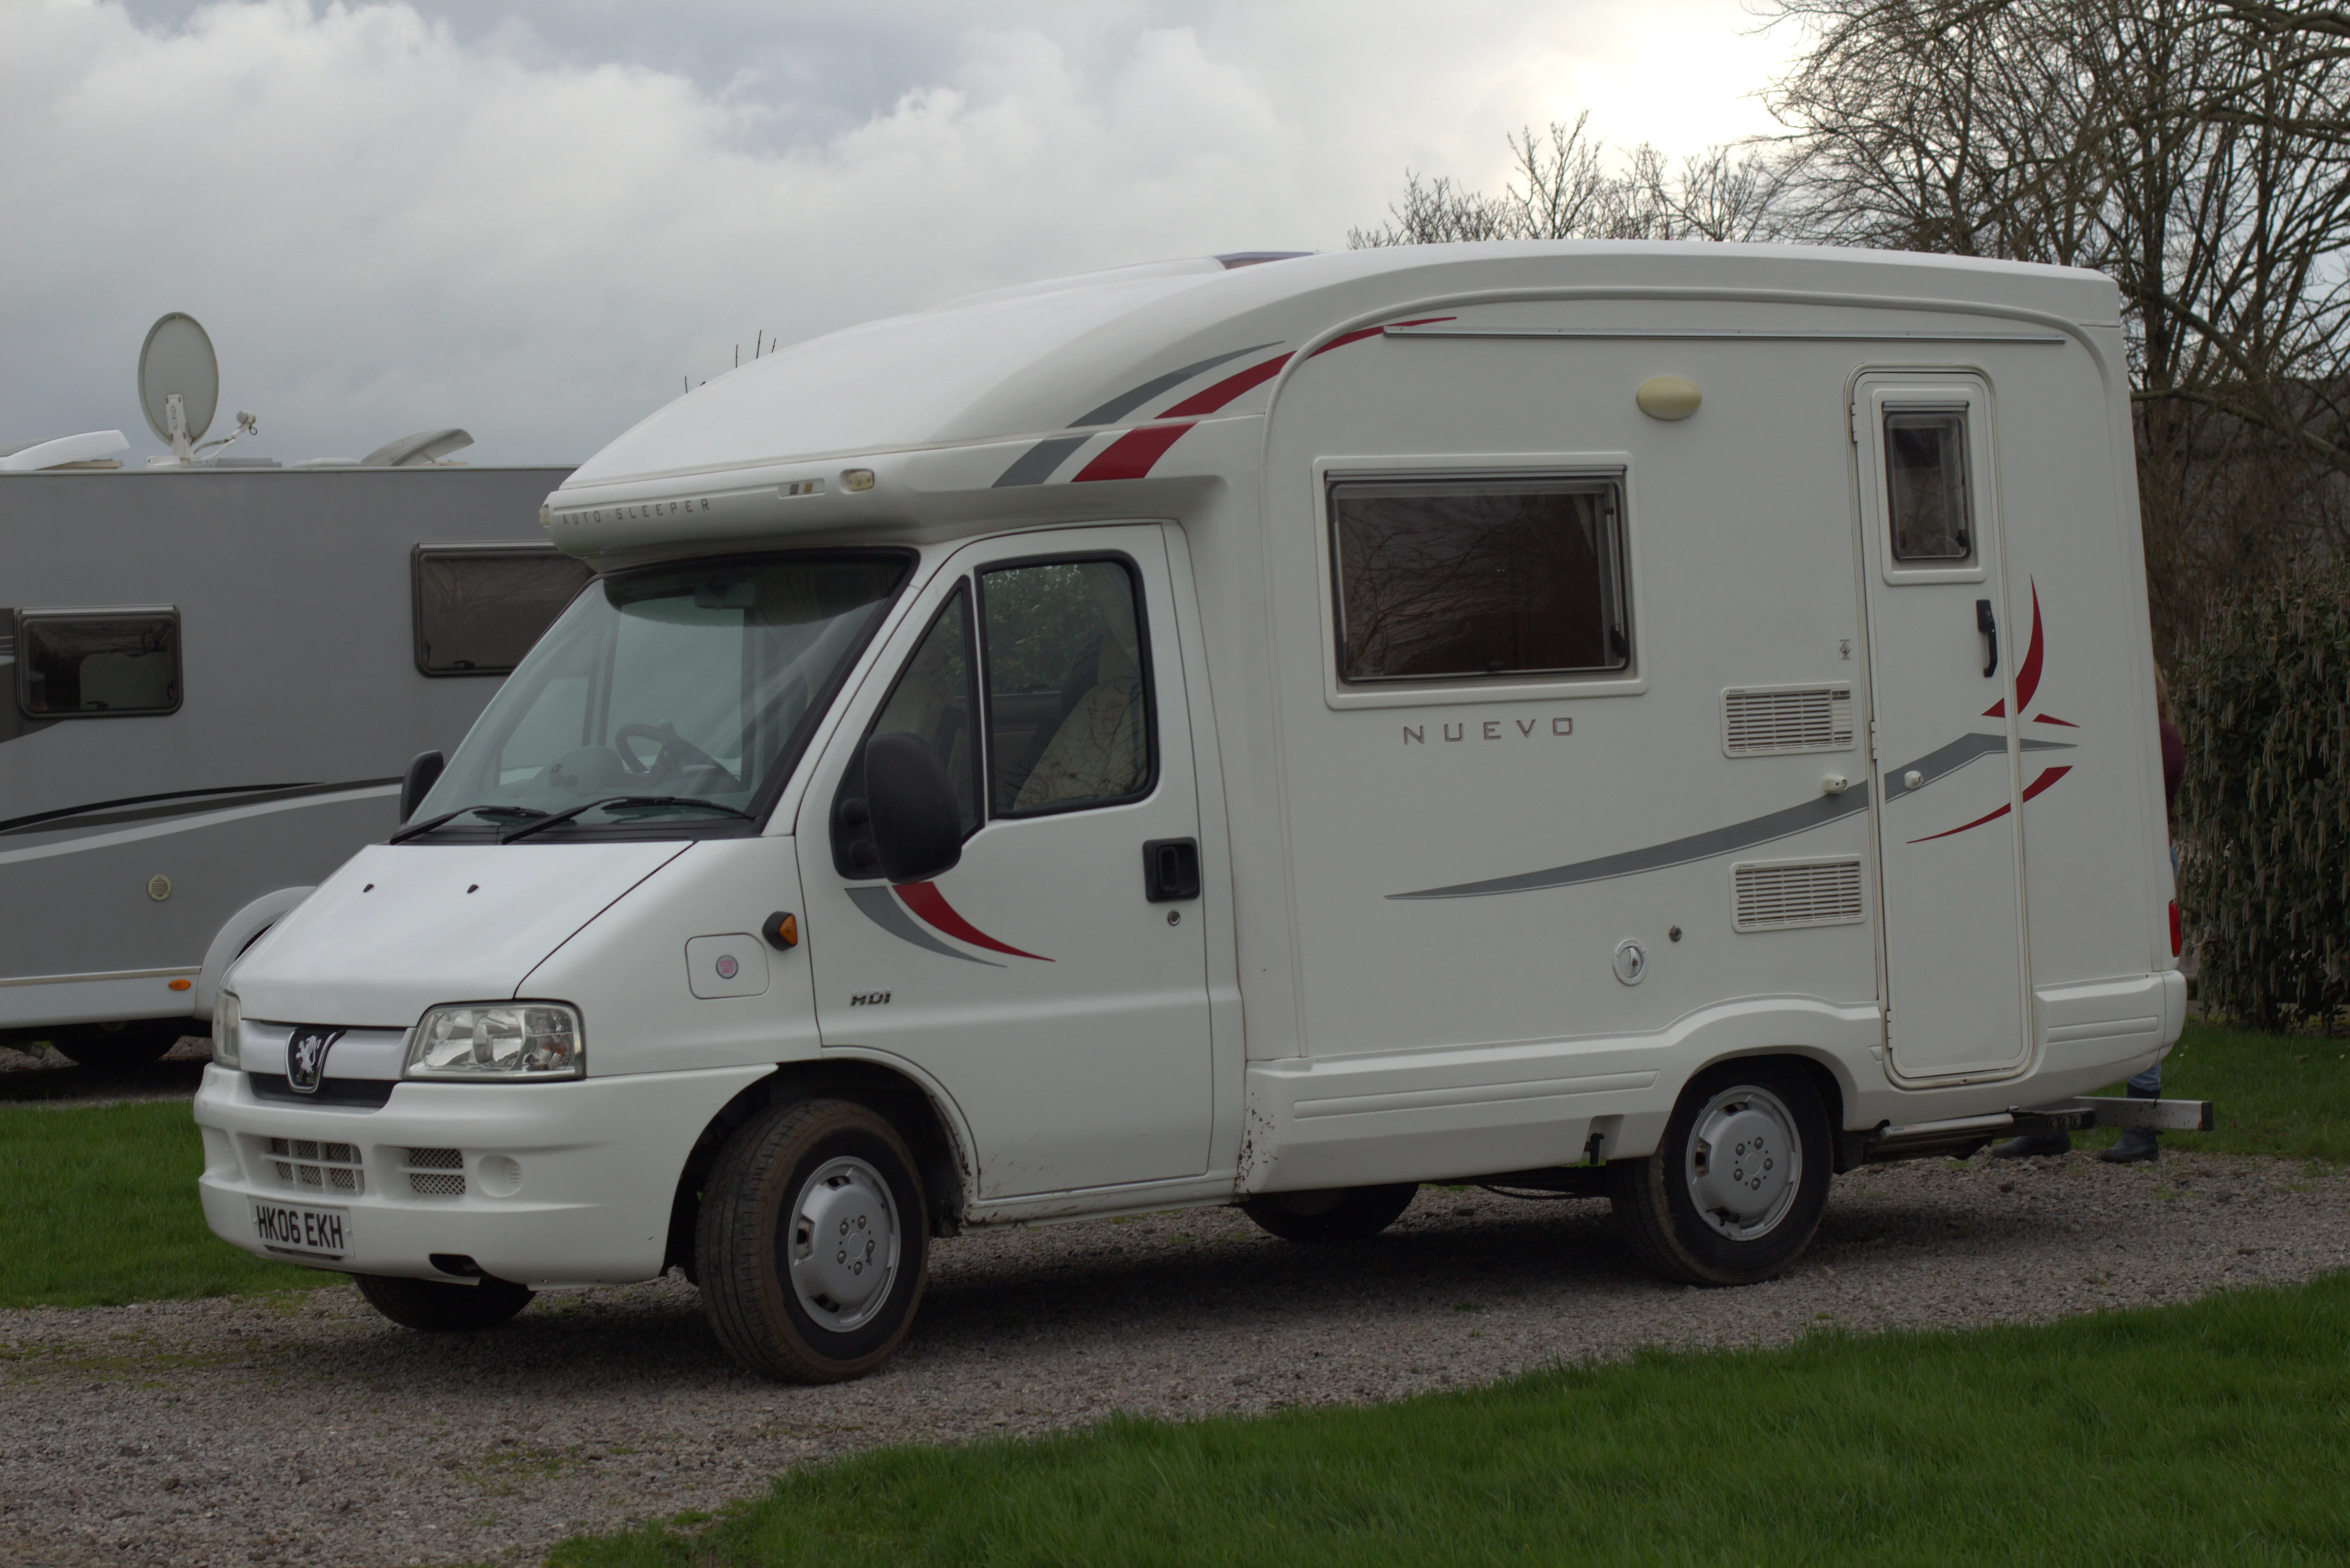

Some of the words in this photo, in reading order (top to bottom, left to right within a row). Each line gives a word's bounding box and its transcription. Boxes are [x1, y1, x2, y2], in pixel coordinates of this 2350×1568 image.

[1403, 717, 1574, 745] NUEVO
[256, 1205, 301, 1244] HK06
[304, 1212, 344, 1249] EKH
